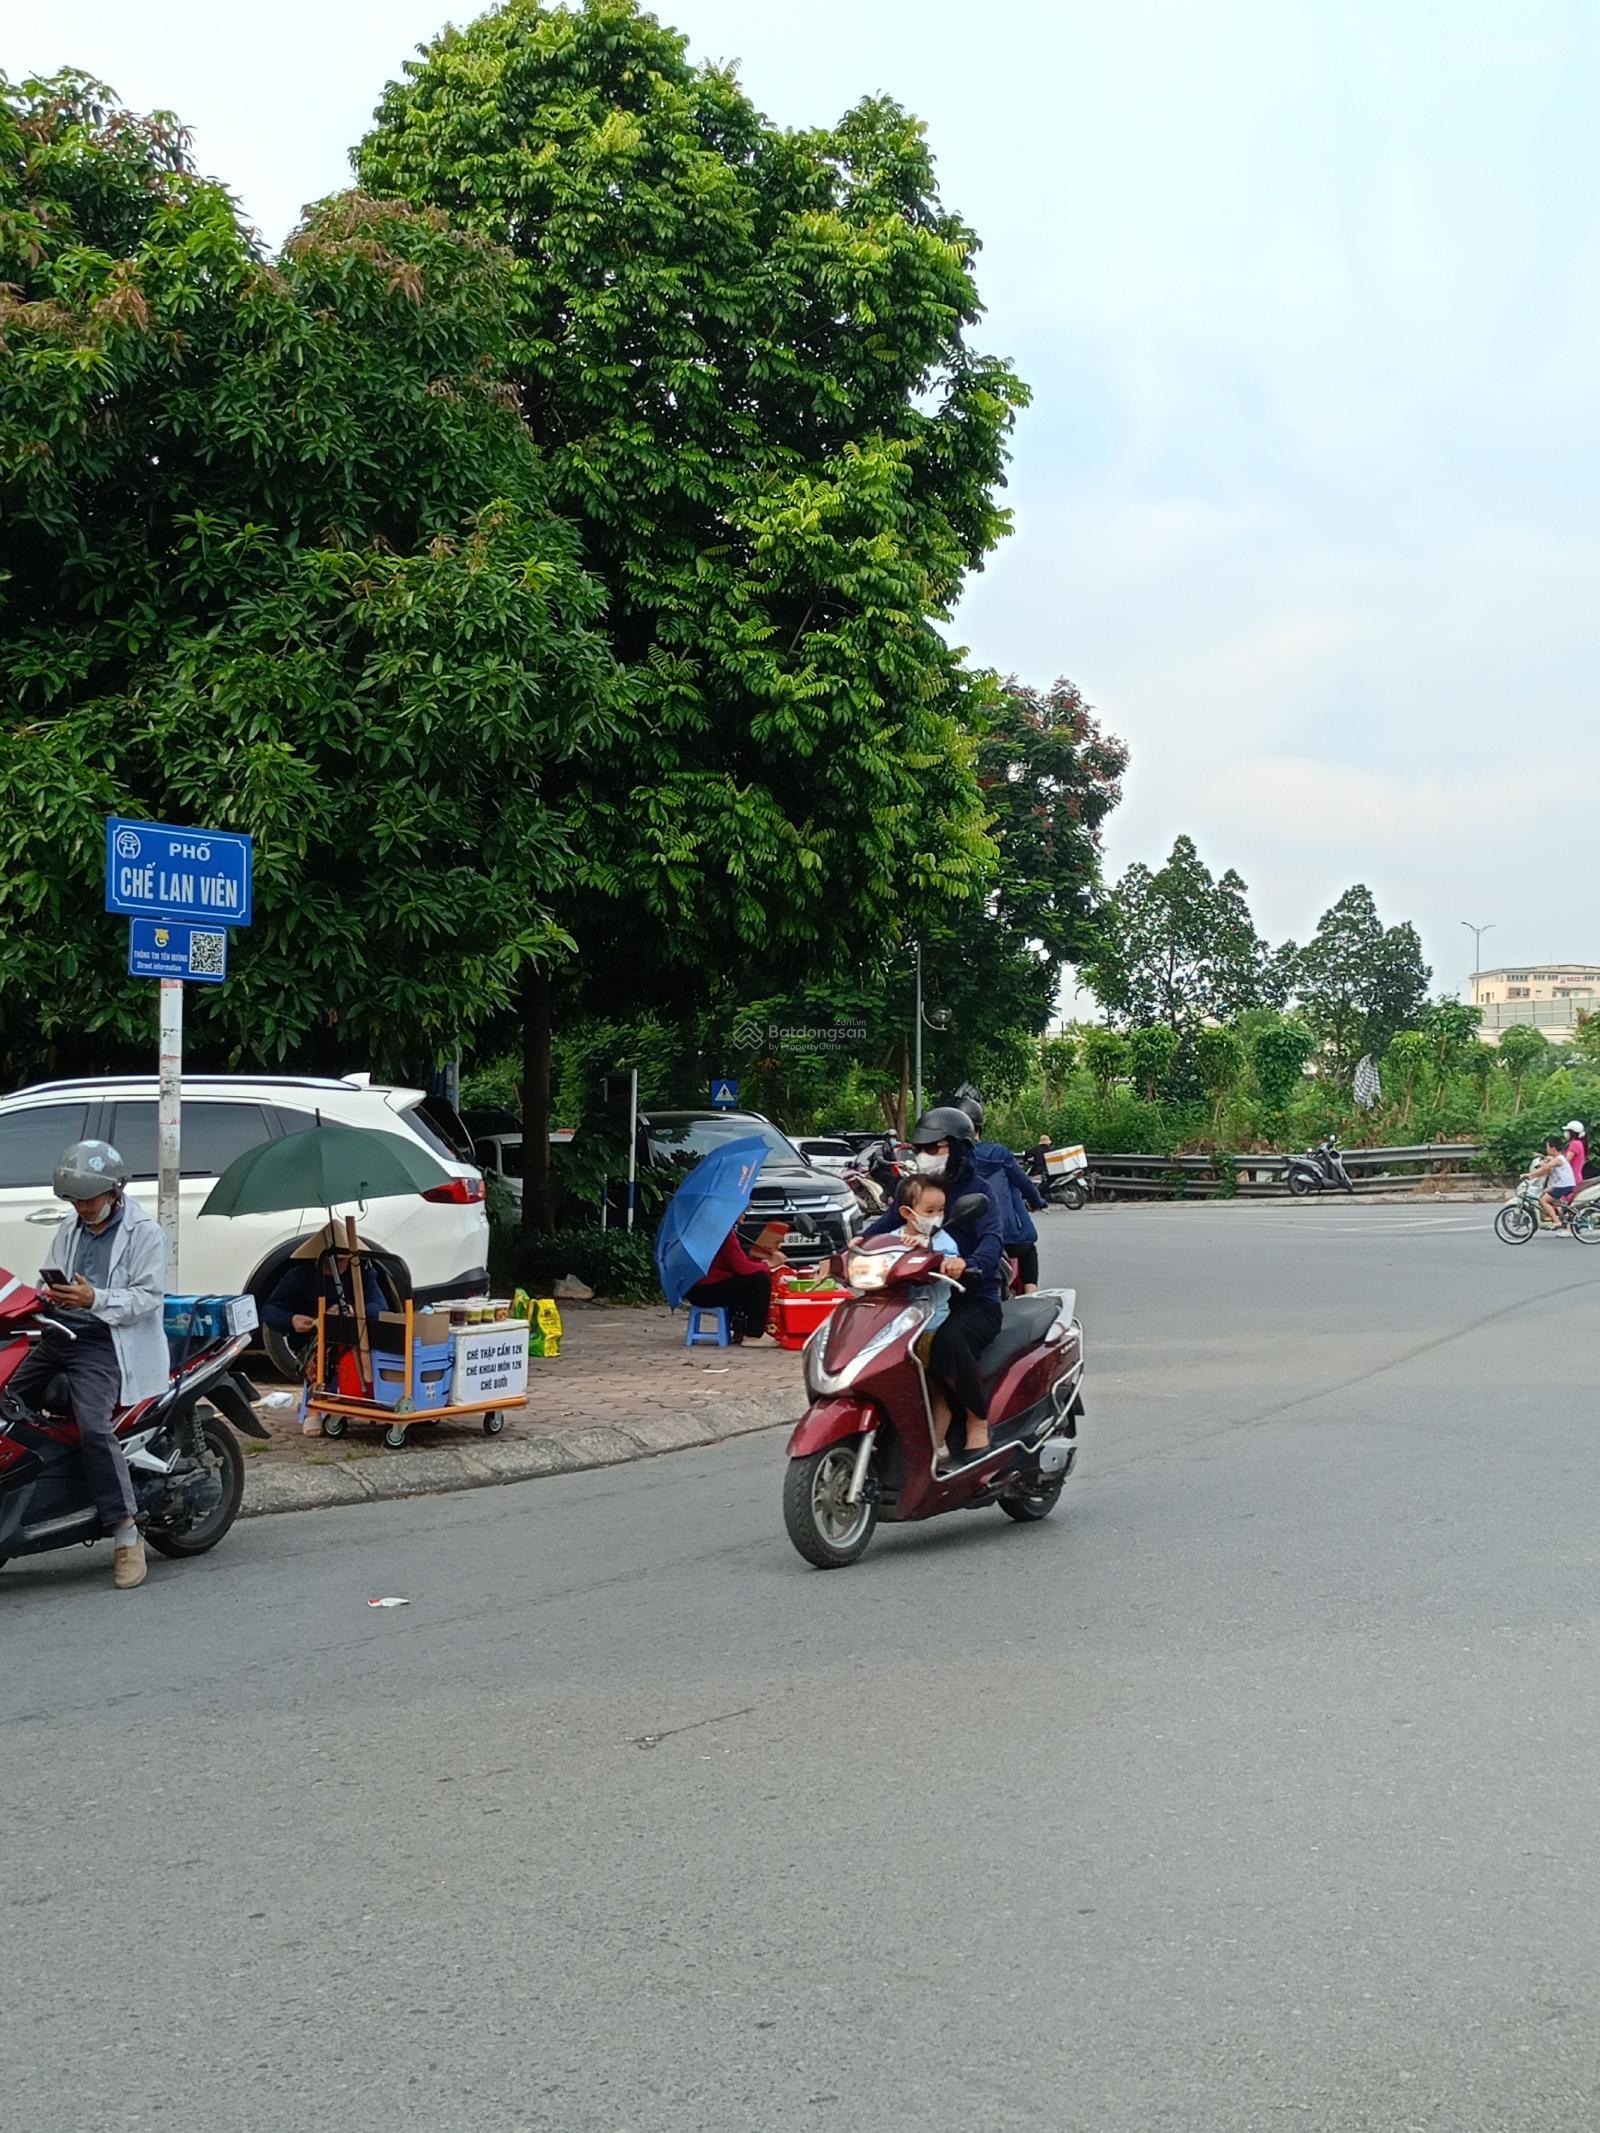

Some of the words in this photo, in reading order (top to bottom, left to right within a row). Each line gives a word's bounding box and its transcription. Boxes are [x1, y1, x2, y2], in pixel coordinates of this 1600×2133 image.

[169, 842, 211, 861] PHỐ
[120, 862, 156, 899] CHẾ
[159, 872, 194, 903] LAN
[200, 872, 238, 908] VIÊN
